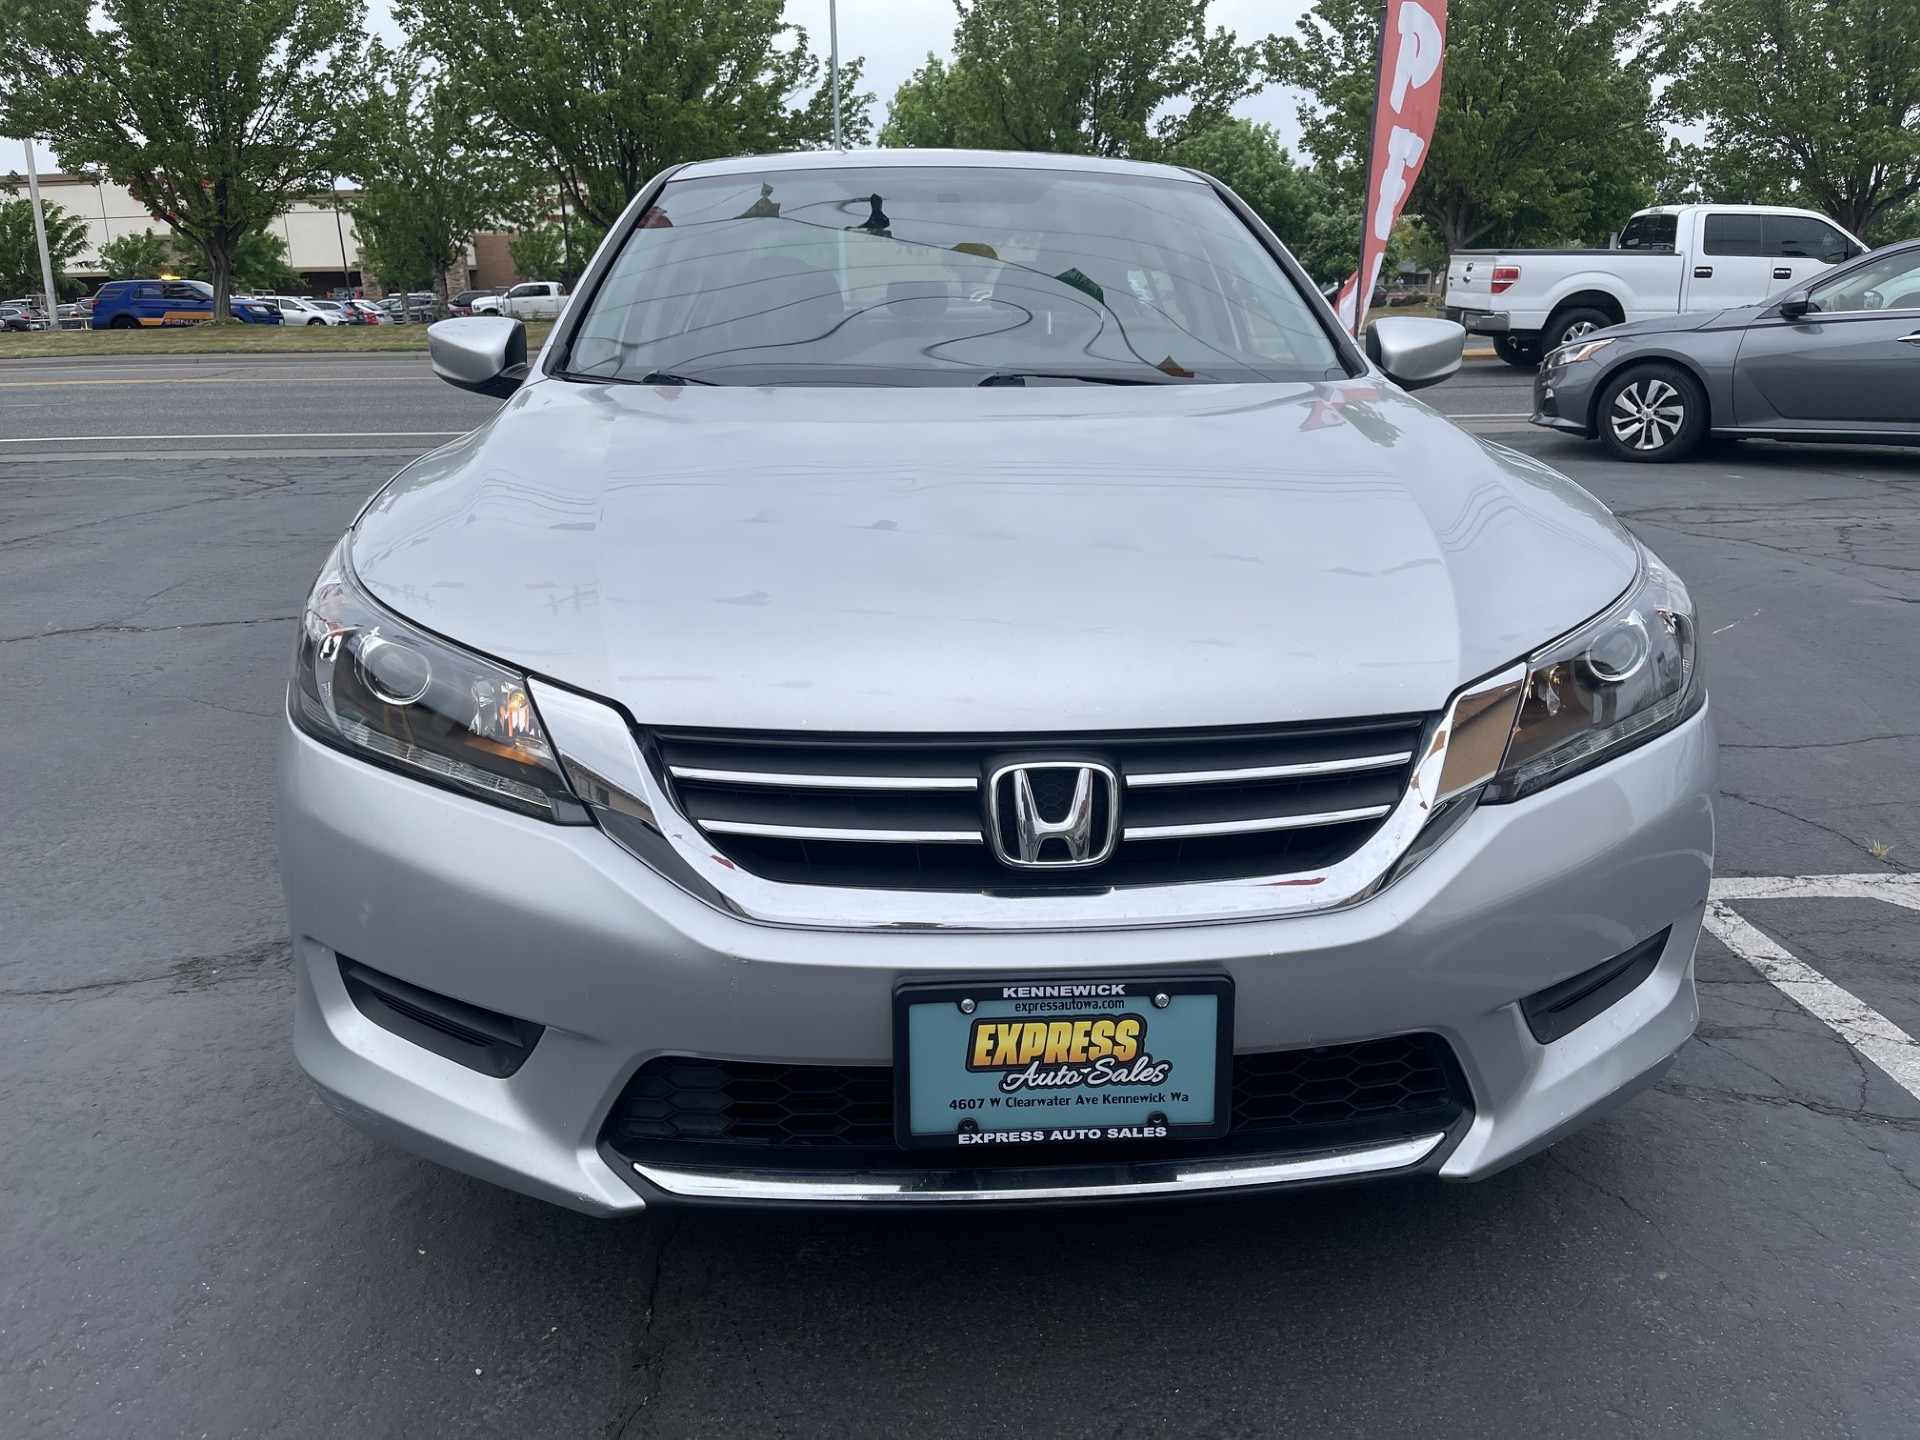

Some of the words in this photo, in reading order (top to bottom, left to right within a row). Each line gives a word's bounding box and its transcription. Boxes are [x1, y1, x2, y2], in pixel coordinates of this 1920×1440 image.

[1003, 984, 1126, 998] KENNEWICK
[1015, 998, 1125, 1014] expressautowa.com
[972, 1019, 1141, 1067] EXPRESS
[1002, 1061, 1083, 1091] Auto
[1087, 1056, 1170, 1085] Sales
[949, 1098, 985, 1110] 4607
[991, 1097, 1001, 1108] W
[1005, 1095, 1070, 1108] Clearwater
[1075, 1095, 1098, 1105] Ave
[1102, 1093, 1166, 1105] Kennewick
[1170, 1092, 1189, 1102] Wa
[958, 1131, 1045, 1145] EXPRESS
[1050, 1129, 1102, 1141] AUTO
[1107, 1127, 1167, 1138] SALES
